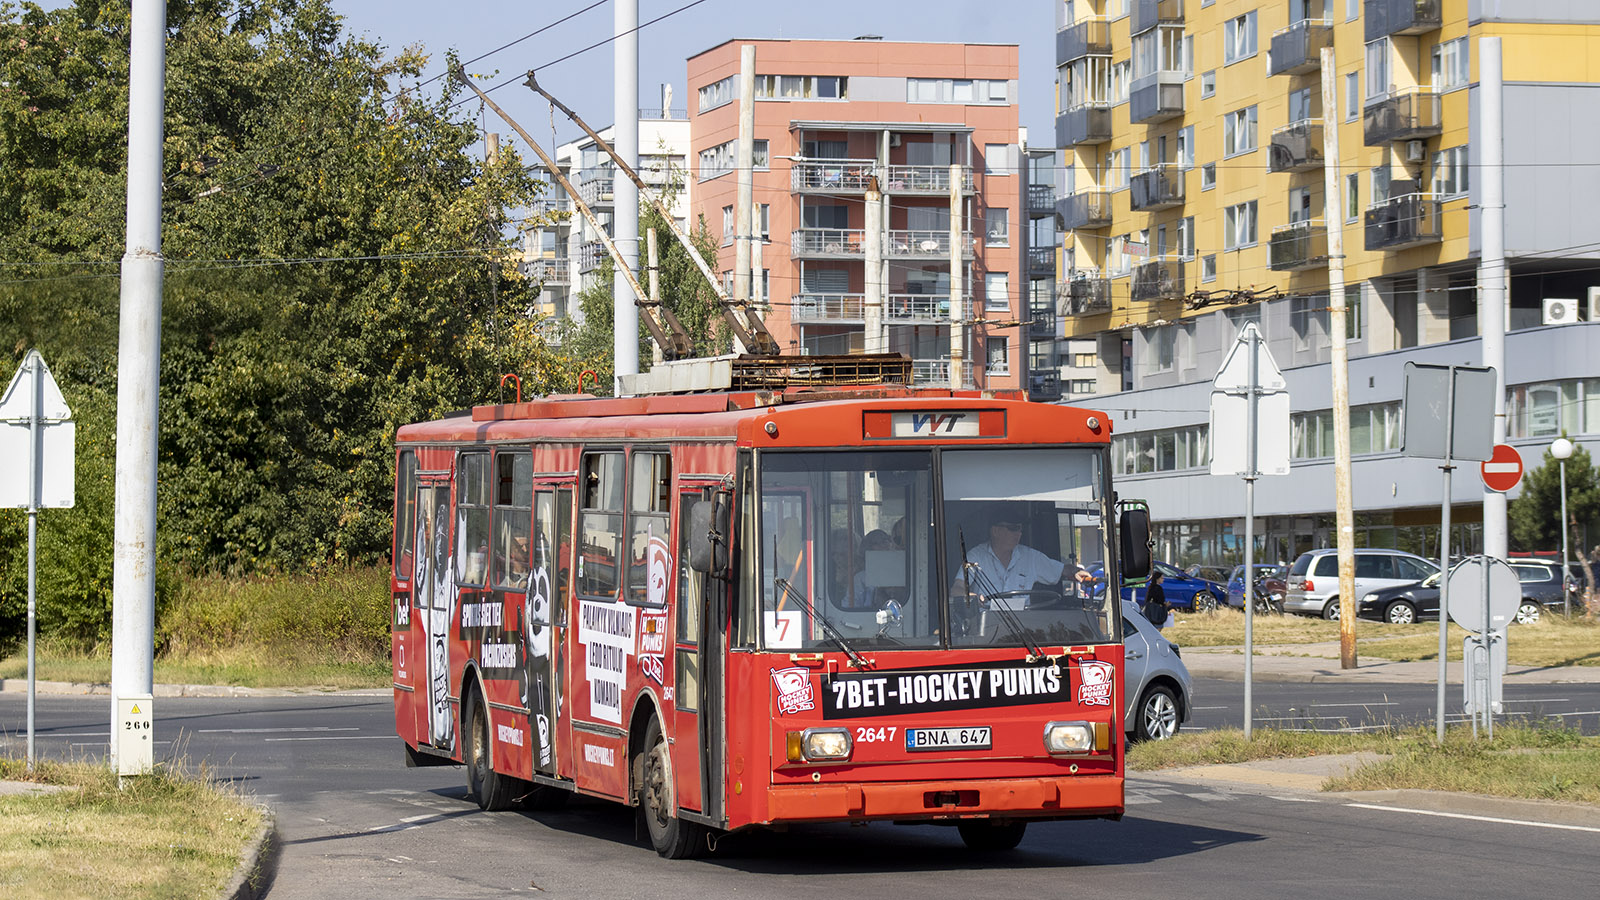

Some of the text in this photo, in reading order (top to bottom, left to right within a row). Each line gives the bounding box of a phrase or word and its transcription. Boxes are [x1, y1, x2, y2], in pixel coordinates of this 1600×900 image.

[912, 413, 966, 433] VVT
[777, 619, 790, 641] 7
[589, 641, 602, 668] LEDO
[832, 664, 1061, 710] 7BET-HOCKEY PUNKS
[1082, 683, 1110, 693] HOCKEY
[1083, 689, 1107, 699] PUNKS
[125, 721, 150, 730] 260
[856, 727, 897, 743] 2647
[917, 731, 950, 745] BNA
[960, 729, 988, 744] 647
